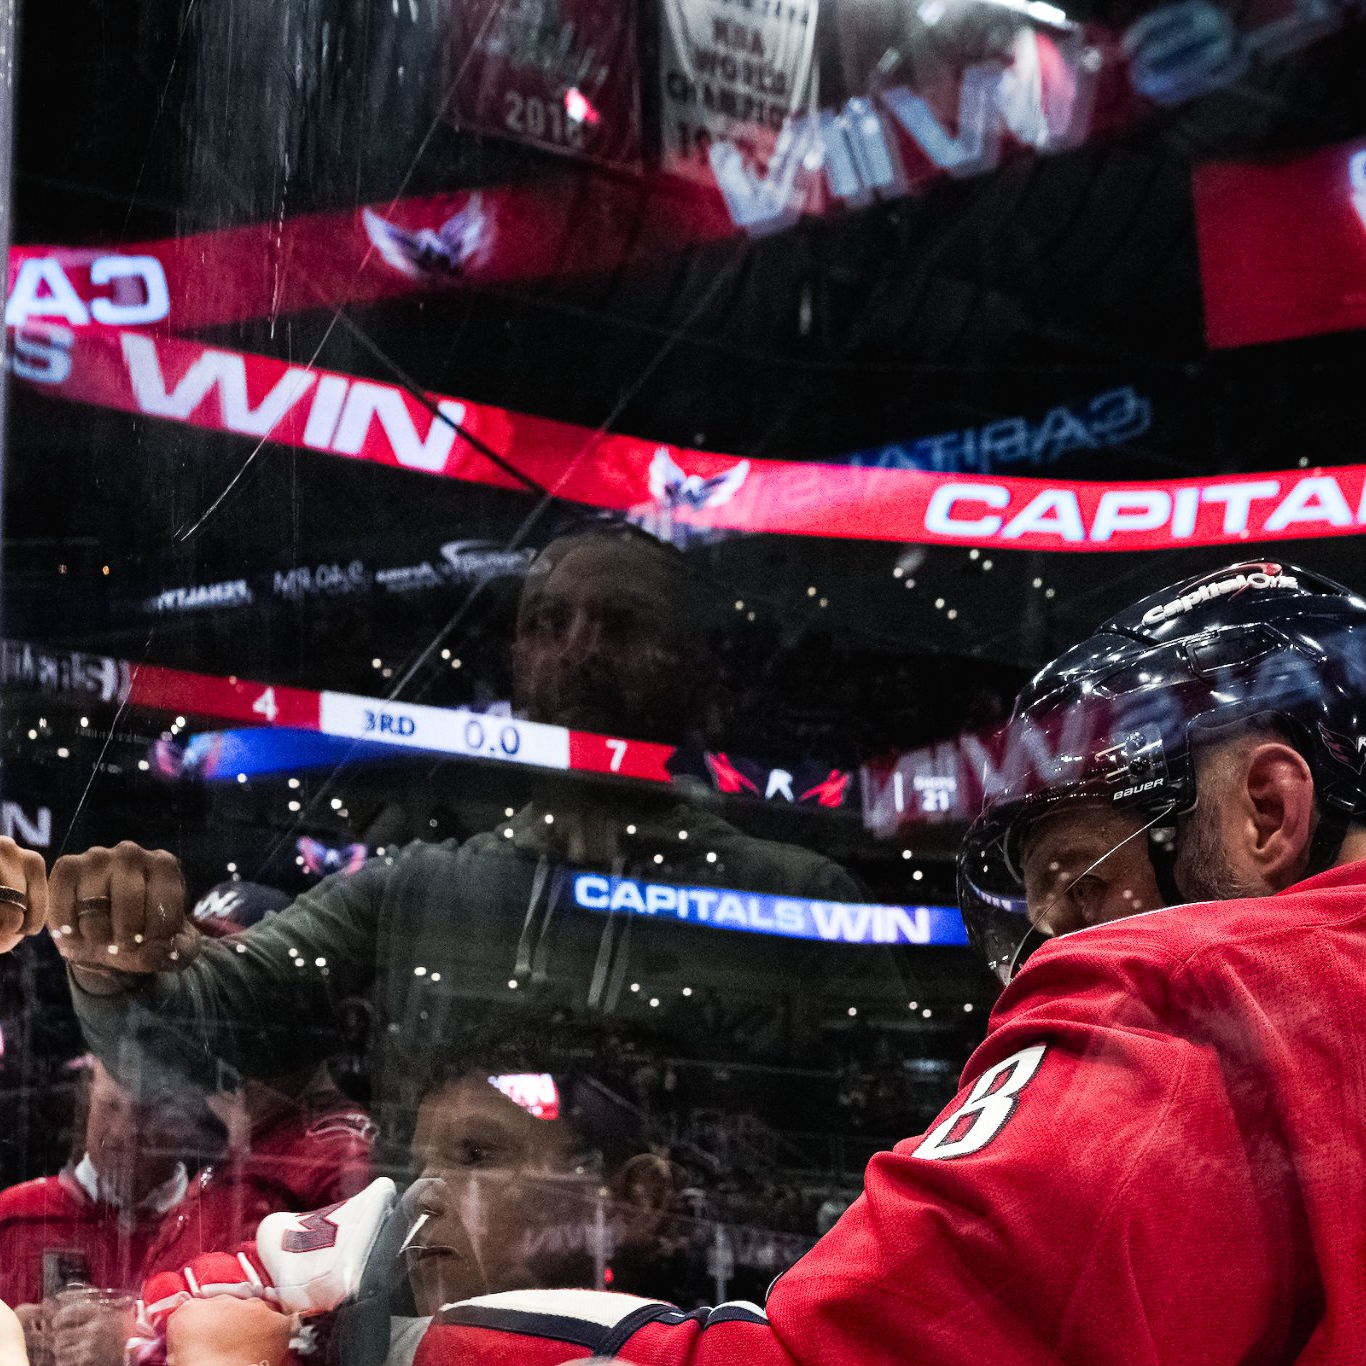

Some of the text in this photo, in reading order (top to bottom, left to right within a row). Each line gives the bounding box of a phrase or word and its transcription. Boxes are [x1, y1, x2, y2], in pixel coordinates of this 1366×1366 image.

[119, 332, 465, 472] WIN
[252, 686, 628, 773] 4 3RD 0.0 7
[1113, 777, 1165, 802] BAUER
[575, 874, 932, 945] CAPITALS WIN
[910, 1043, 1047, 1162] 8
